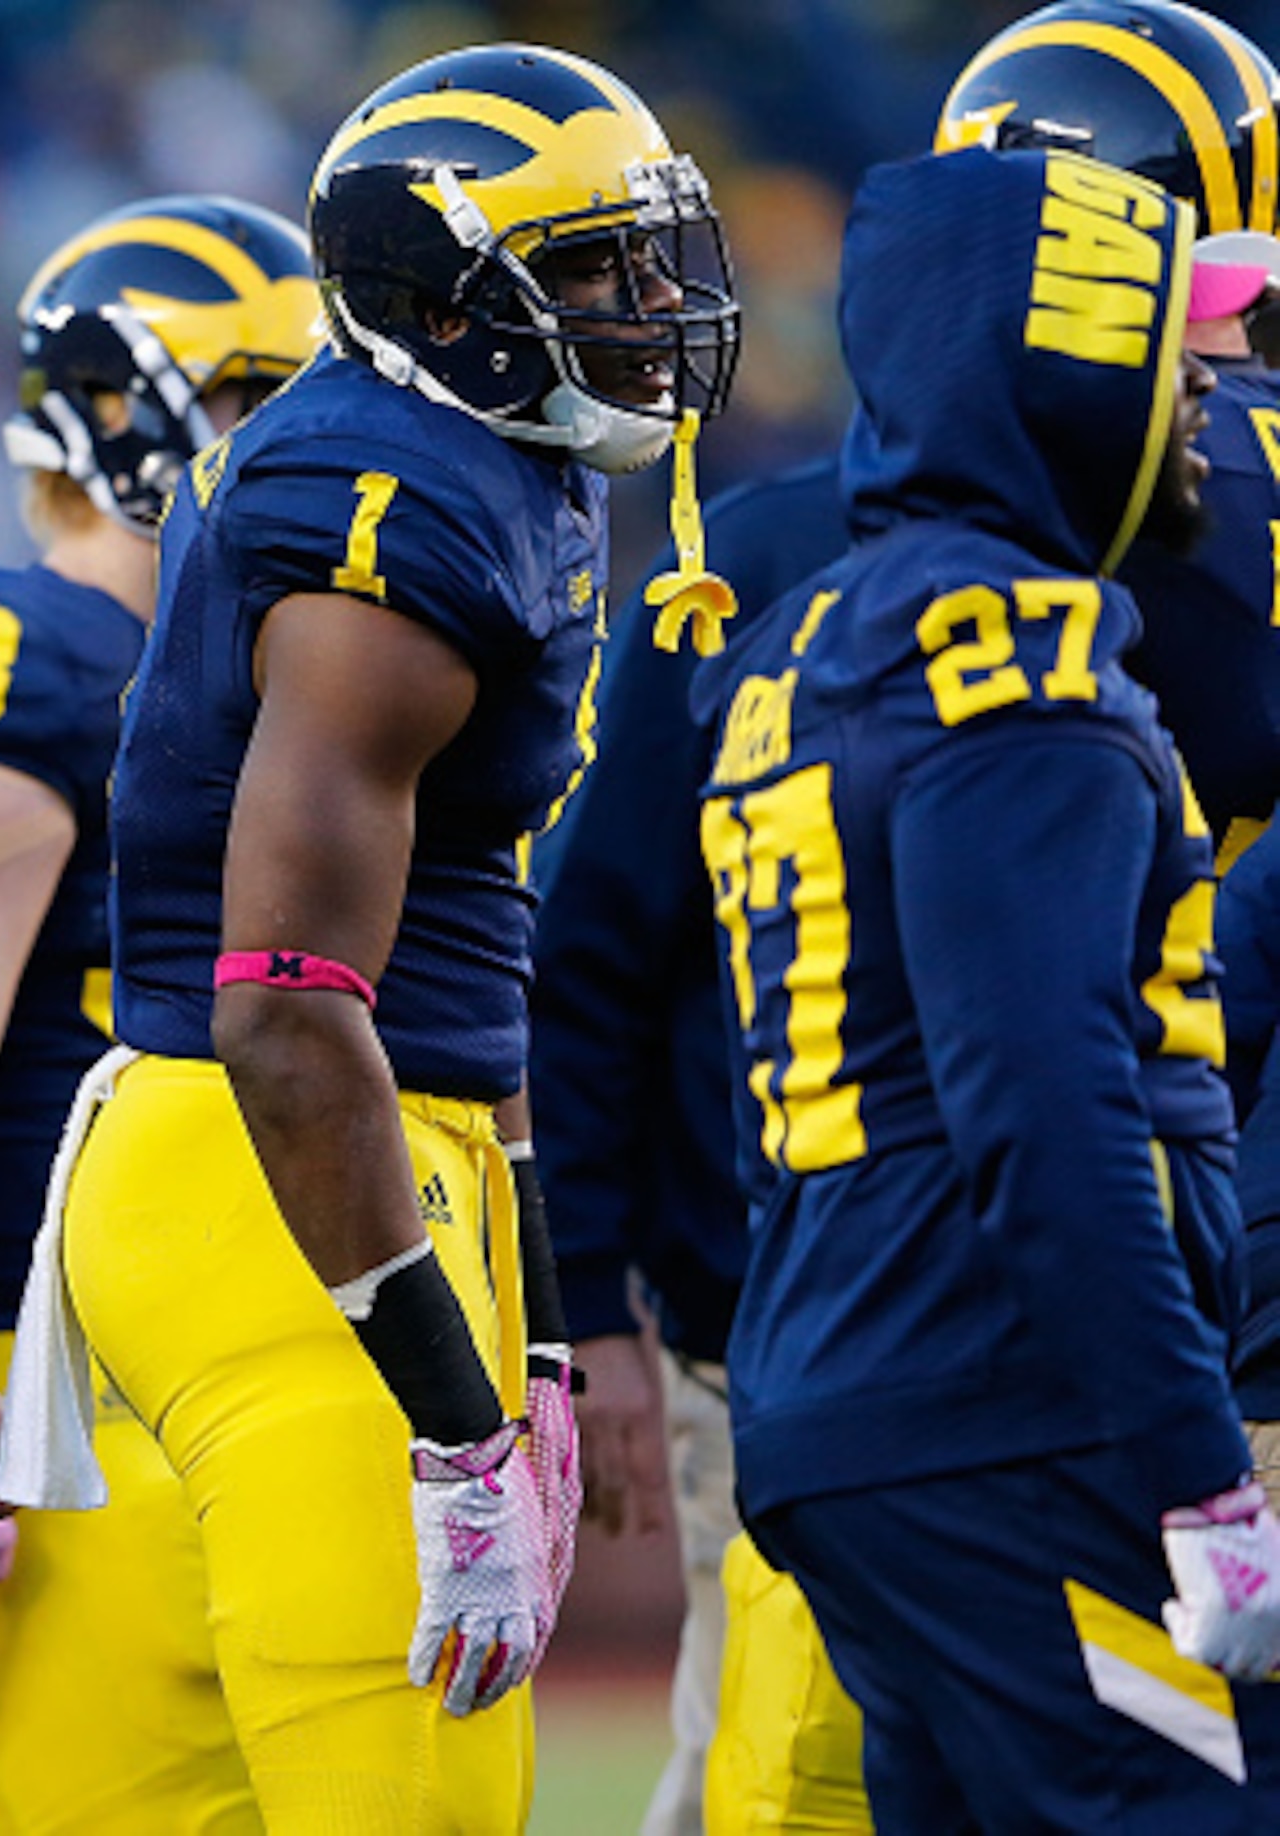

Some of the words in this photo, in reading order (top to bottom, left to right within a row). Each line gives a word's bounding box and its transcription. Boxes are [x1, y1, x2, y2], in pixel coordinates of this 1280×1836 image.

[1024, 150, 1166, 368] GAN
[332, 471, 400, 598] 1
[916, 579, 1101, 726] 27
